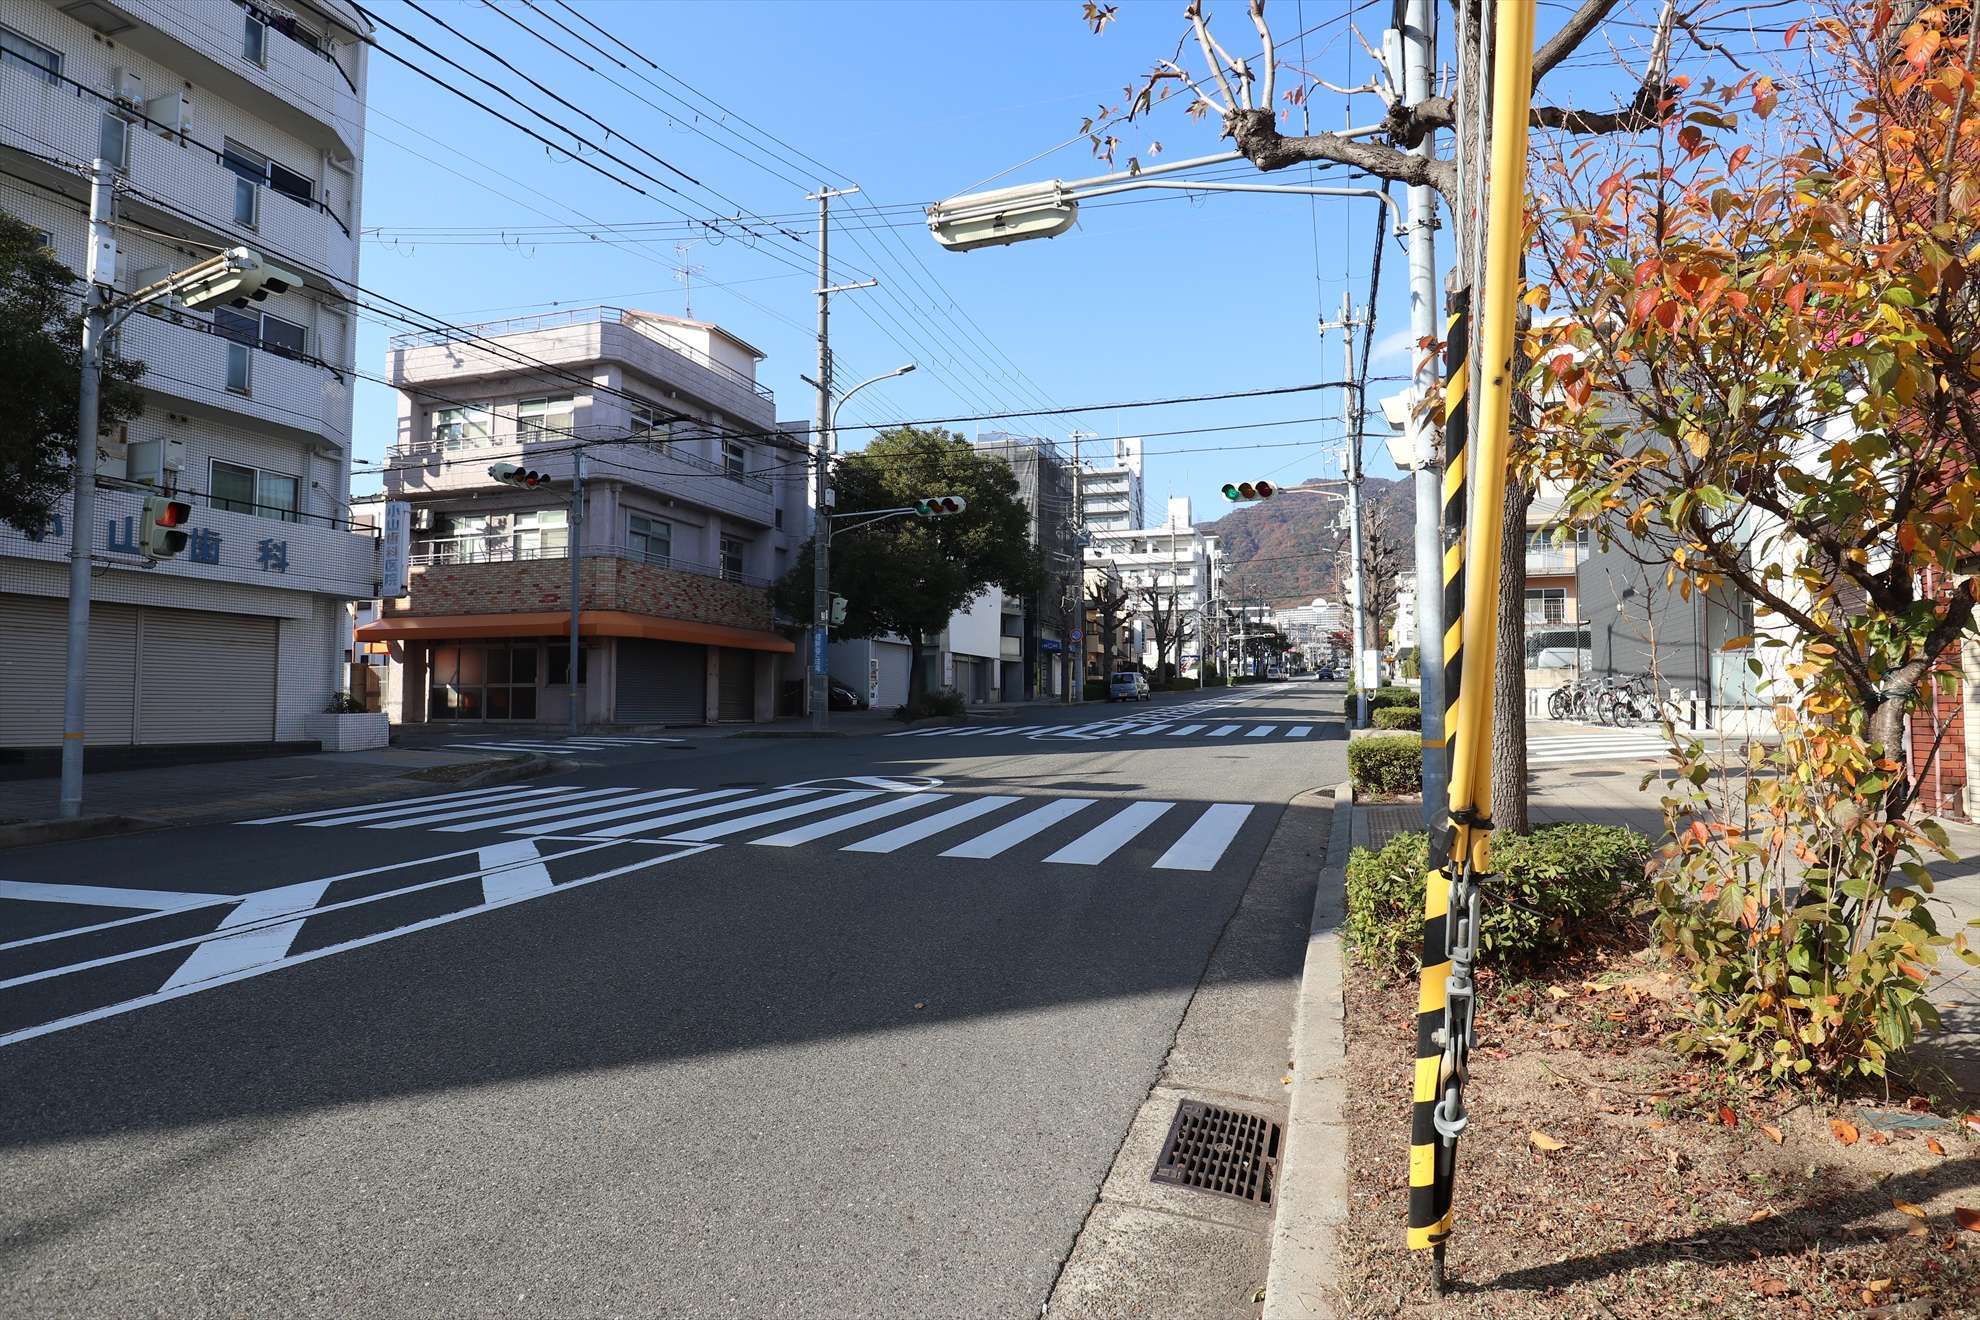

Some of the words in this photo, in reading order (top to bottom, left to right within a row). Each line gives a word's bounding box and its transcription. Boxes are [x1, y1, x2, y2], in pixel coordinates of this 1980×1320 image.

[384, 504, 401, 586] 小山歯科医院
